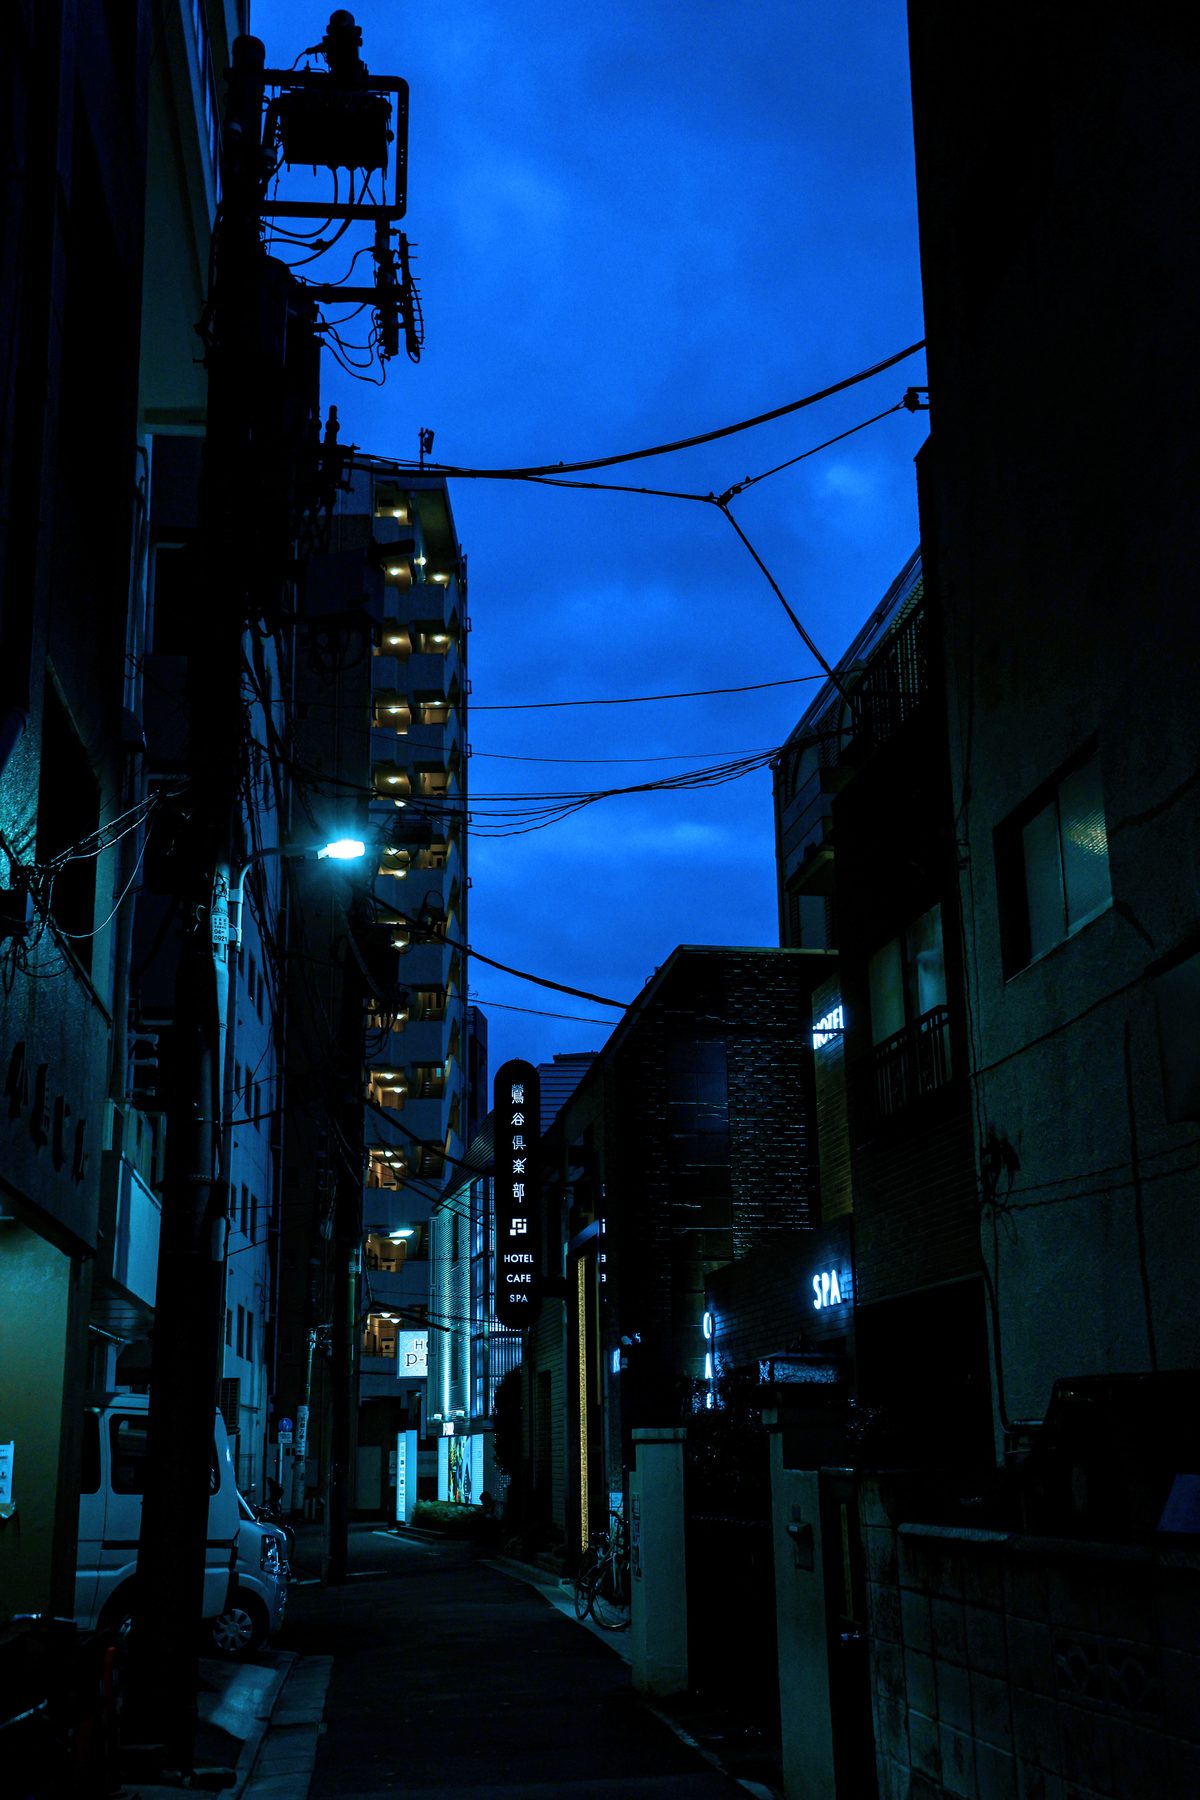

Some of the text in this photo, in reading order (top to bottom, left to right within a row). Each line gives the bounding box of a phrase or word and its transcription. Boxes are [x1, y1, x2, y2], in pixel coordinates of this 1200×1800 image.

[503, 1254, 534, 1263] HOTEL
[506, 1274, 532, 1283] CAFE
[813, 1269, 841, 1310] SPA
[509, 1294, 528, 1303] SPA
